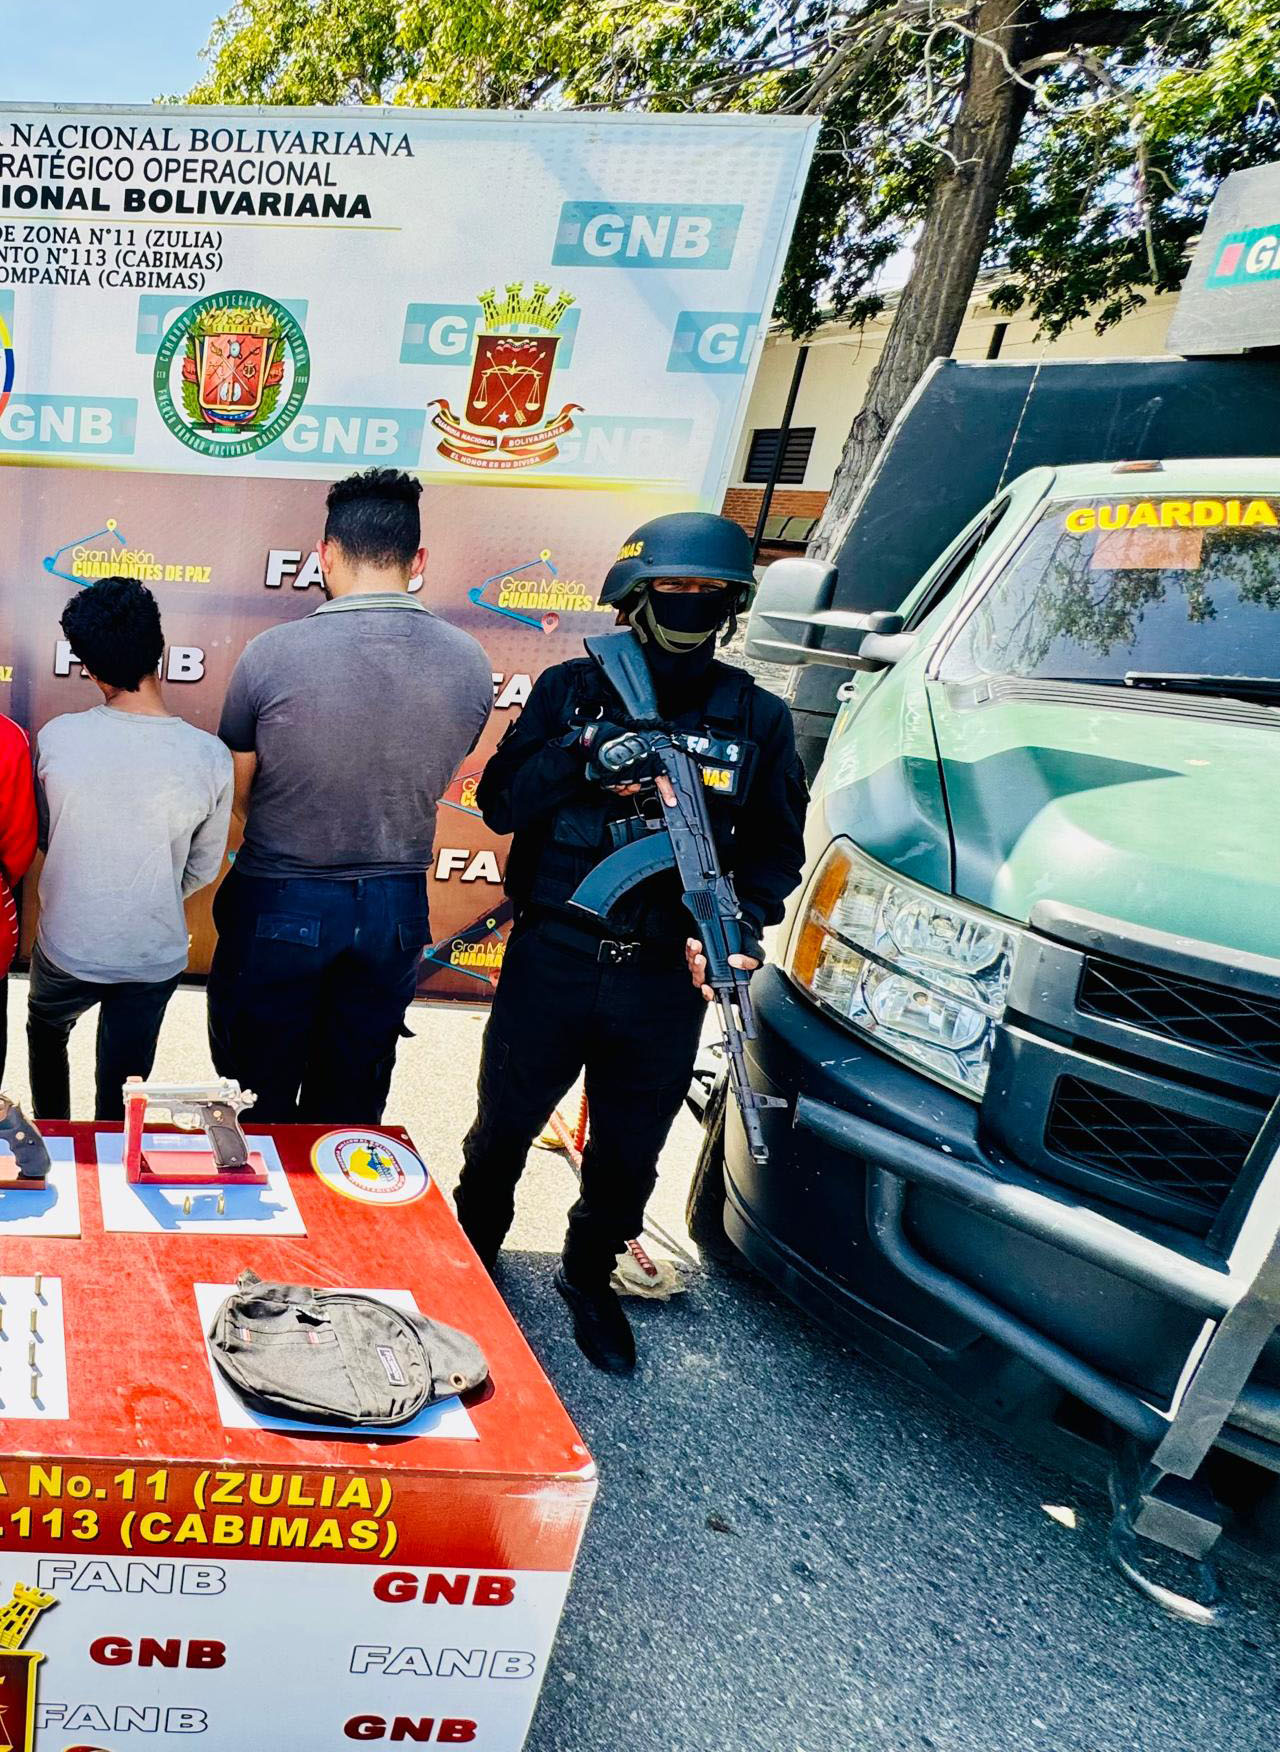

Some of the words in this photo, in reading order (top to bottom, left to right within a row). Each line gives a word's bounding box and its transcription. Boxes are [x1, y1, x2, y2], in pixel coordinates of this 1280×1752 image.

[11, 125, 181, 152] NACIONAL
[189, 130, 416, 158] BOLIVARIANA
[142, 157, 338, 187] OPERACIONAL
[124, 187, 372, 218] BOLIVARIANA
[23, 226, 82, 245] ZONA
[145, 229, 223, 251] (ZULIA)
[582, 214, 713, 258] GNB
[115, 249, 223, 272] (CABIMAS)
[98, 269, 206, 292] (CABIMAS)
[0, 406, 112, 443] GNB
[282, 414, 398, 455] GNB
[462, 432, 496, 447] NACIONAL
[508, 426, 565, 447] BOLIVARIANA
[1065, 500, 1280, 533] GUARDIA
[72, 546, 108, 562] Gran
[111, 548, 154, 564] Misión
[72, 562, 162, 580] CUADRANTES
[165, 565, 183, 582] DE
[185, 566, 211, 583] PAZ
[500, 577, 537, 592] Gran
[540, 579, 585, 595] Misión
[498, 592, 593, 611] CUADRANTES
[29, 1465, 169, 1502] No.11
[193, 1470, 395, 1518] (ZULIA)
[120, 1511, 399, 1559] (CABIMAS)
[36, 1559, 227, 1596] FANB
[373, 1571, 517, 1607] GNB
[88, 1636, 227, 1670] GNB
[349, 1645, 536, 1680] FANB
[36, 1703, 209, 1734] FANB
[344, 1714, 478, 1743] GNB
